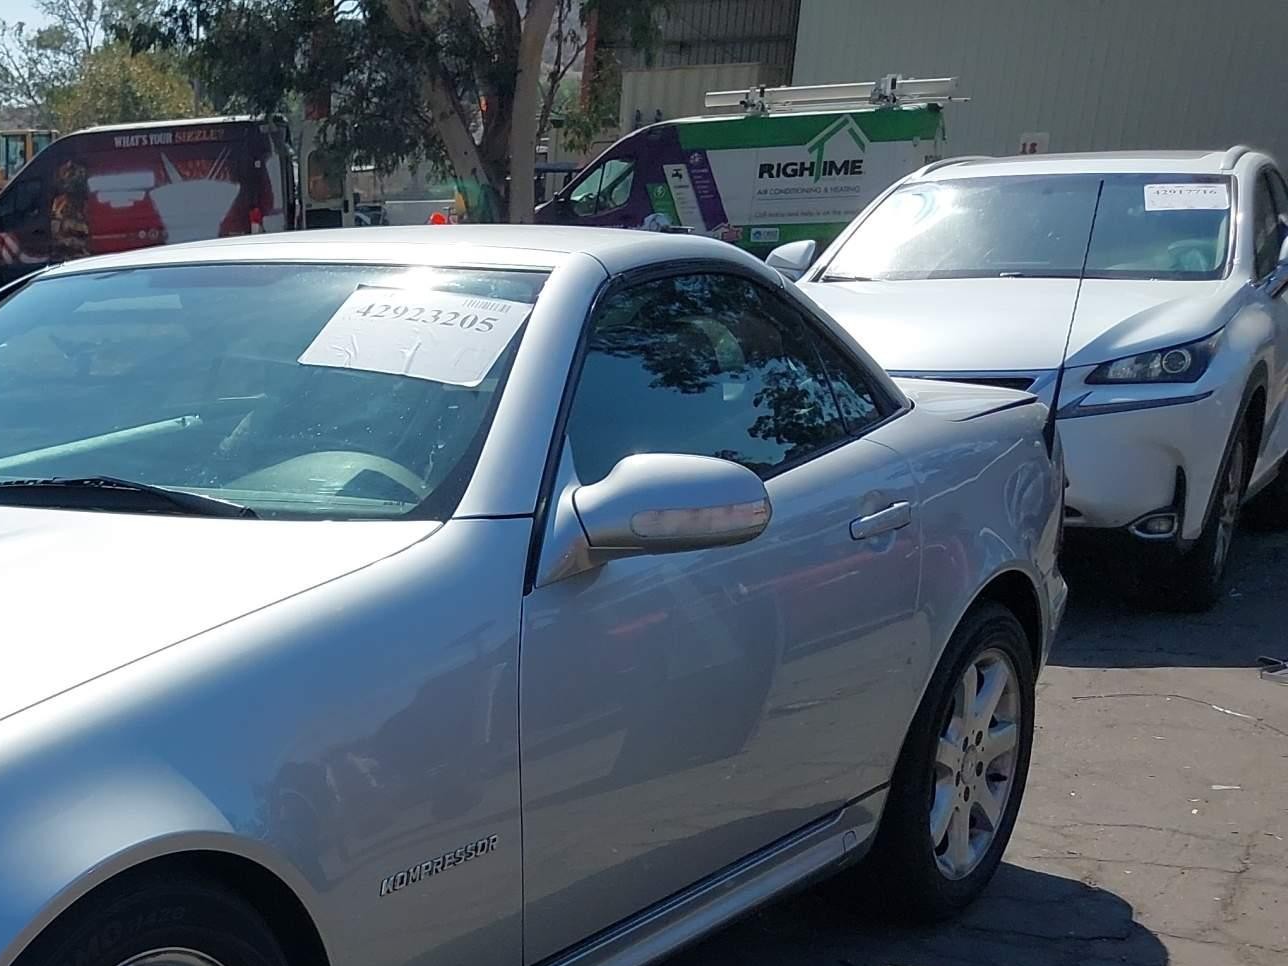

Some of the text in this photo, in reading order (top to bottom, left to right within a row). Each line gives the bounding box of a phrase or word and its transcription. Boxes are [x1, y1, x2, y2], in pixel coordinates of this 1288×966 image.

[149, 132, 173, 145] YOUR
[769, 186, 822, 196] CONDITIONING
[830, 185, 861, 194] HEATING
[355, 303, 499, 333] 42923205
[379, 834, 499, 896] KOMPRESSOR
